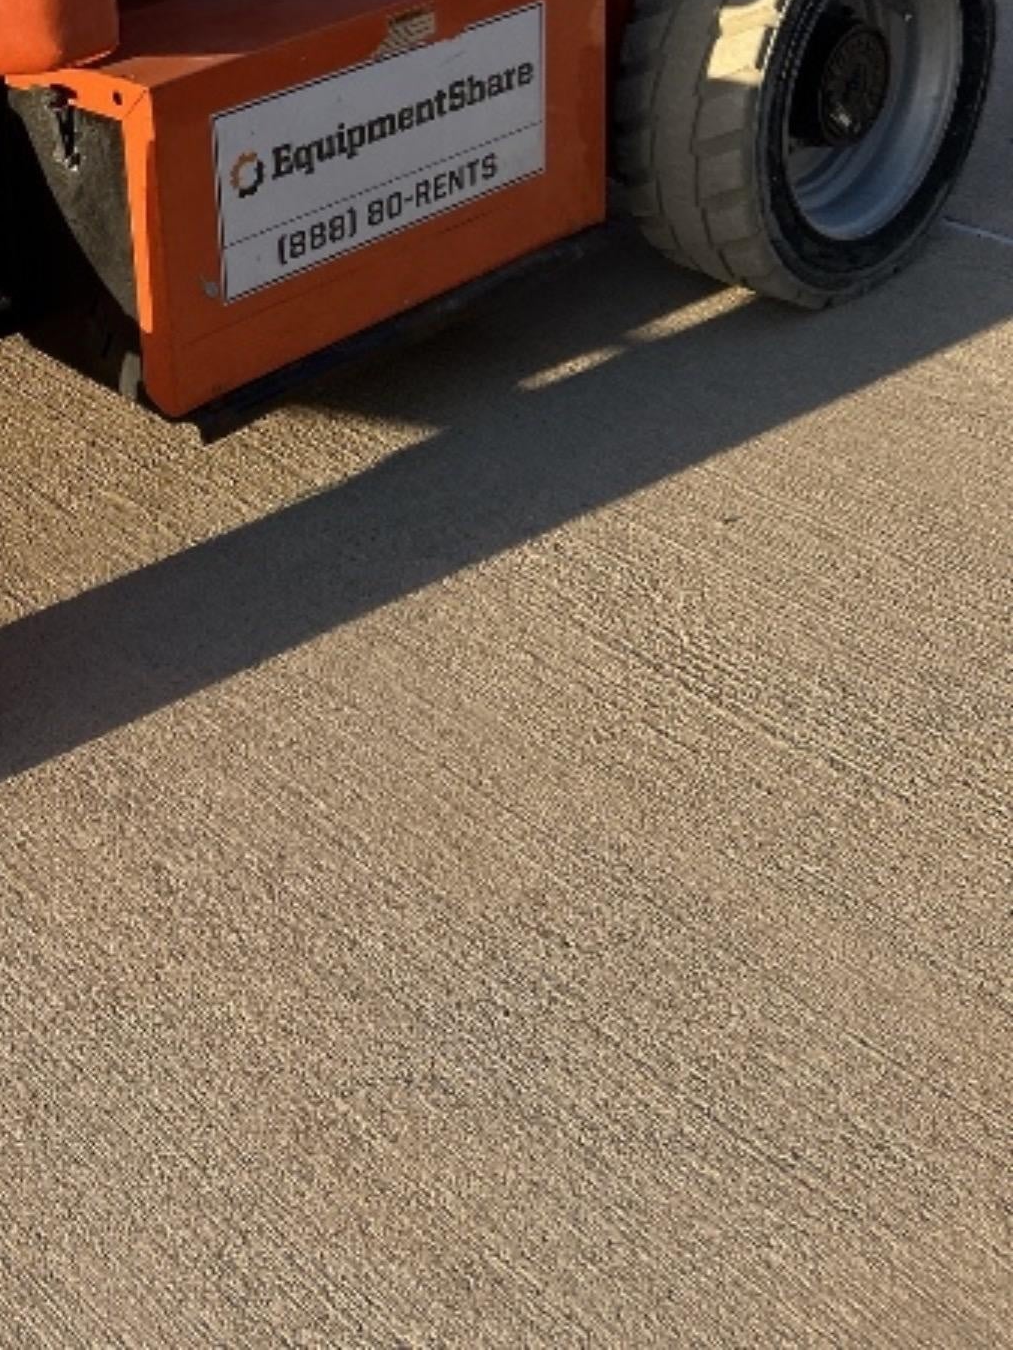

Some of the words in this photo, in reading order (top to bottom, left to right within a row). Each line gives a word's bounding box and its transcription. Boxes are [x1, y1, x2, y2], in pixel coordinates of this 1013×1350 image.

[271, 60, 535, 180] EquipmentShare
[276, 208, 358, 266] (888)
[367, 153, 500, 227] 80-RENTS
